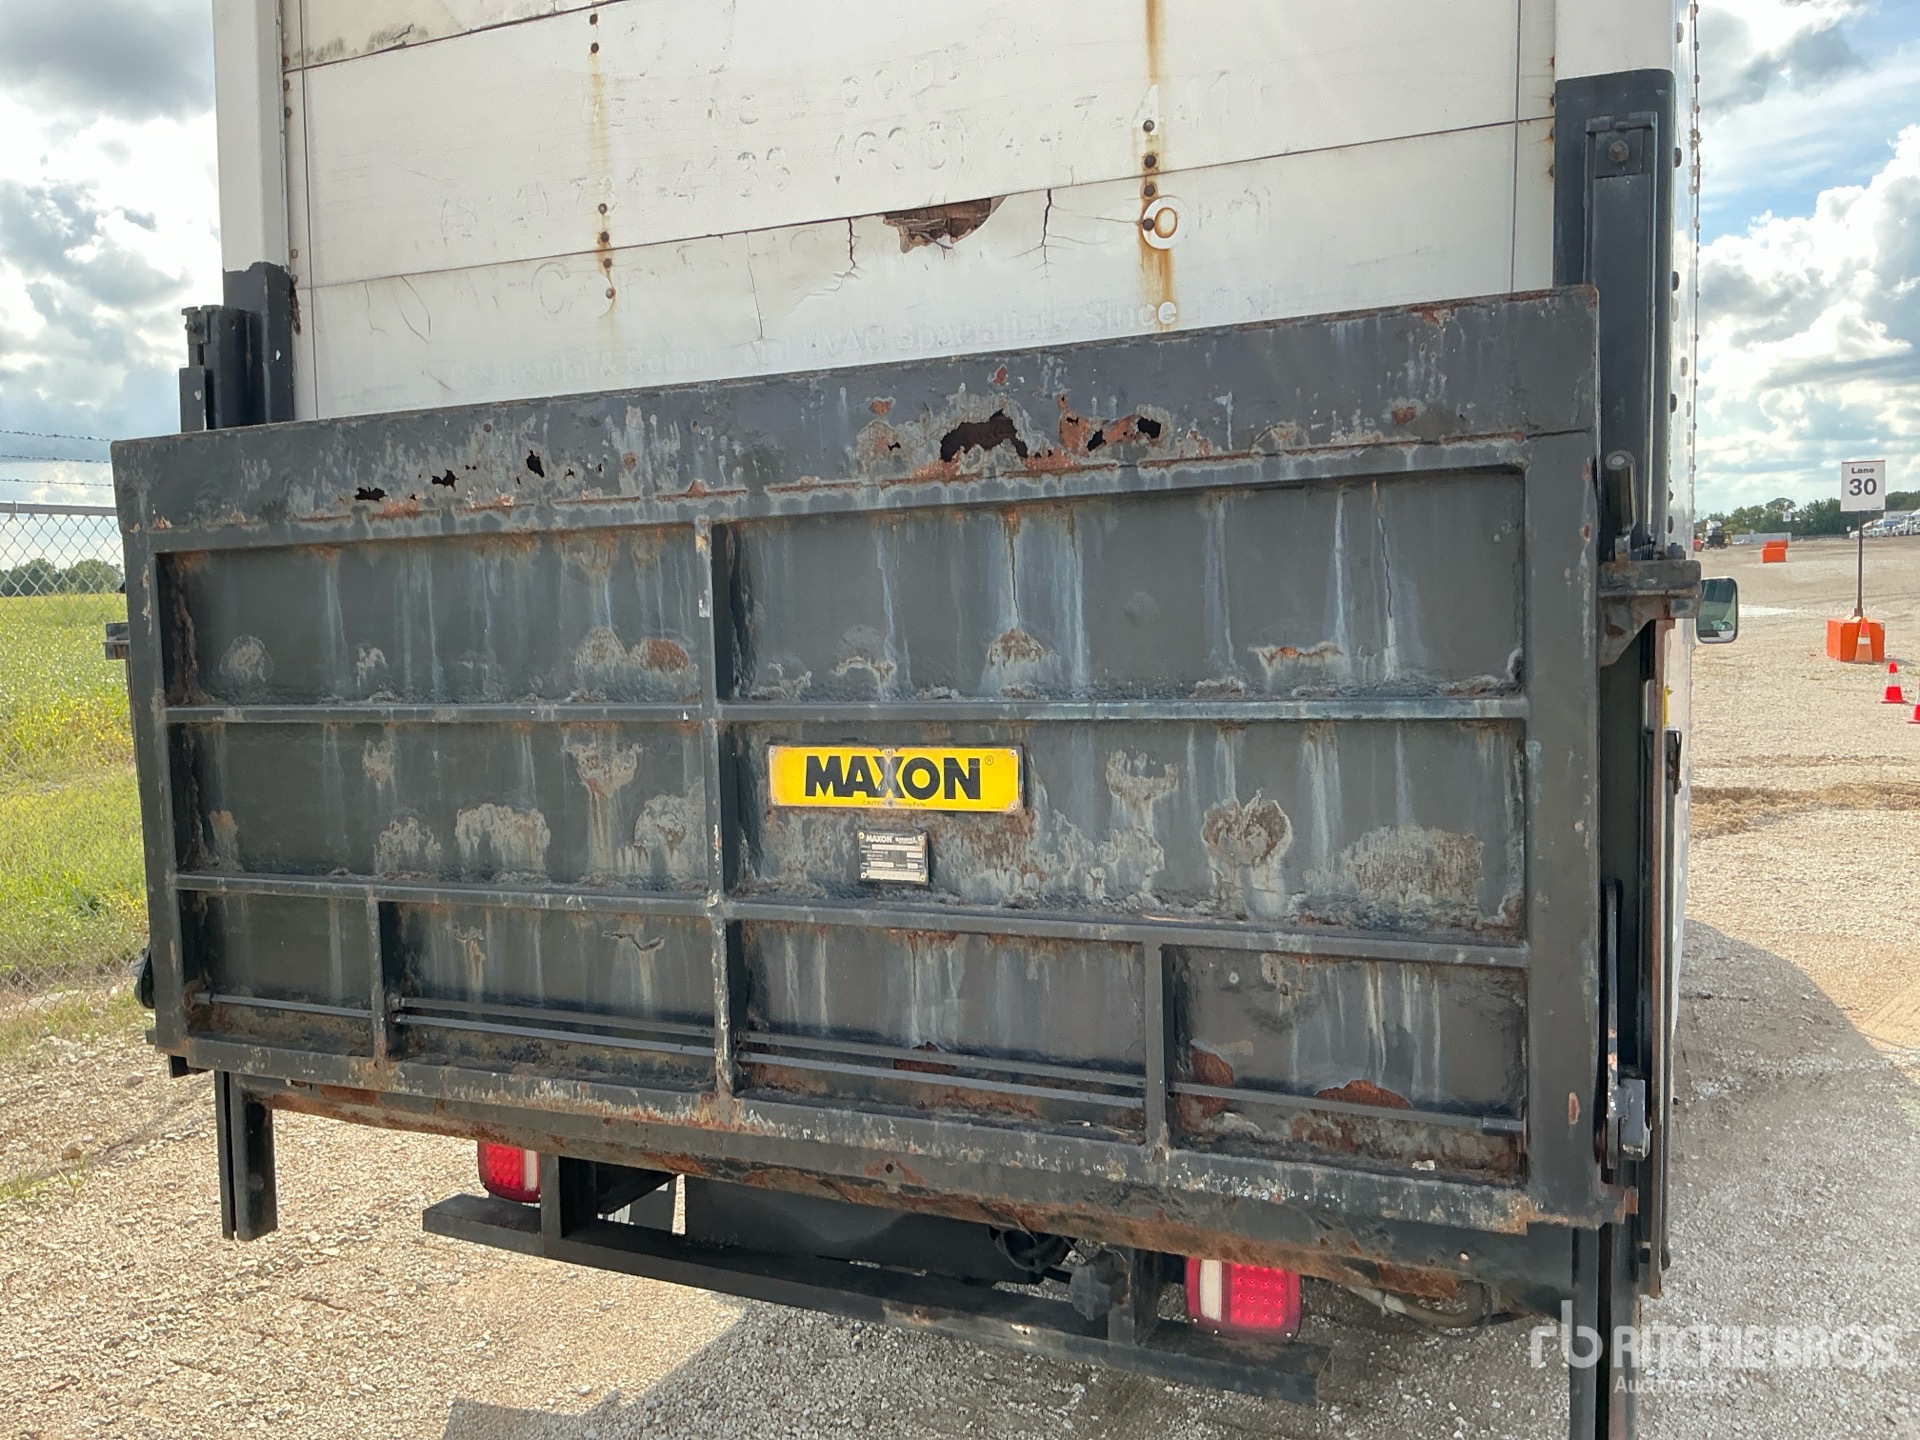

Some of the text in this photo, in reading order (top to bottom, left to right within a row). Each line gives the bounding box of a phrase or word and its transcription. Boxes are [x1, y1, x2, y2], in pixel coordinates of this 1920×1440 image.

[1849, 478, 1877, 496] 30
[805, 756, 981, 800] MAXON
[866, 834, 893, 844] MAXON
